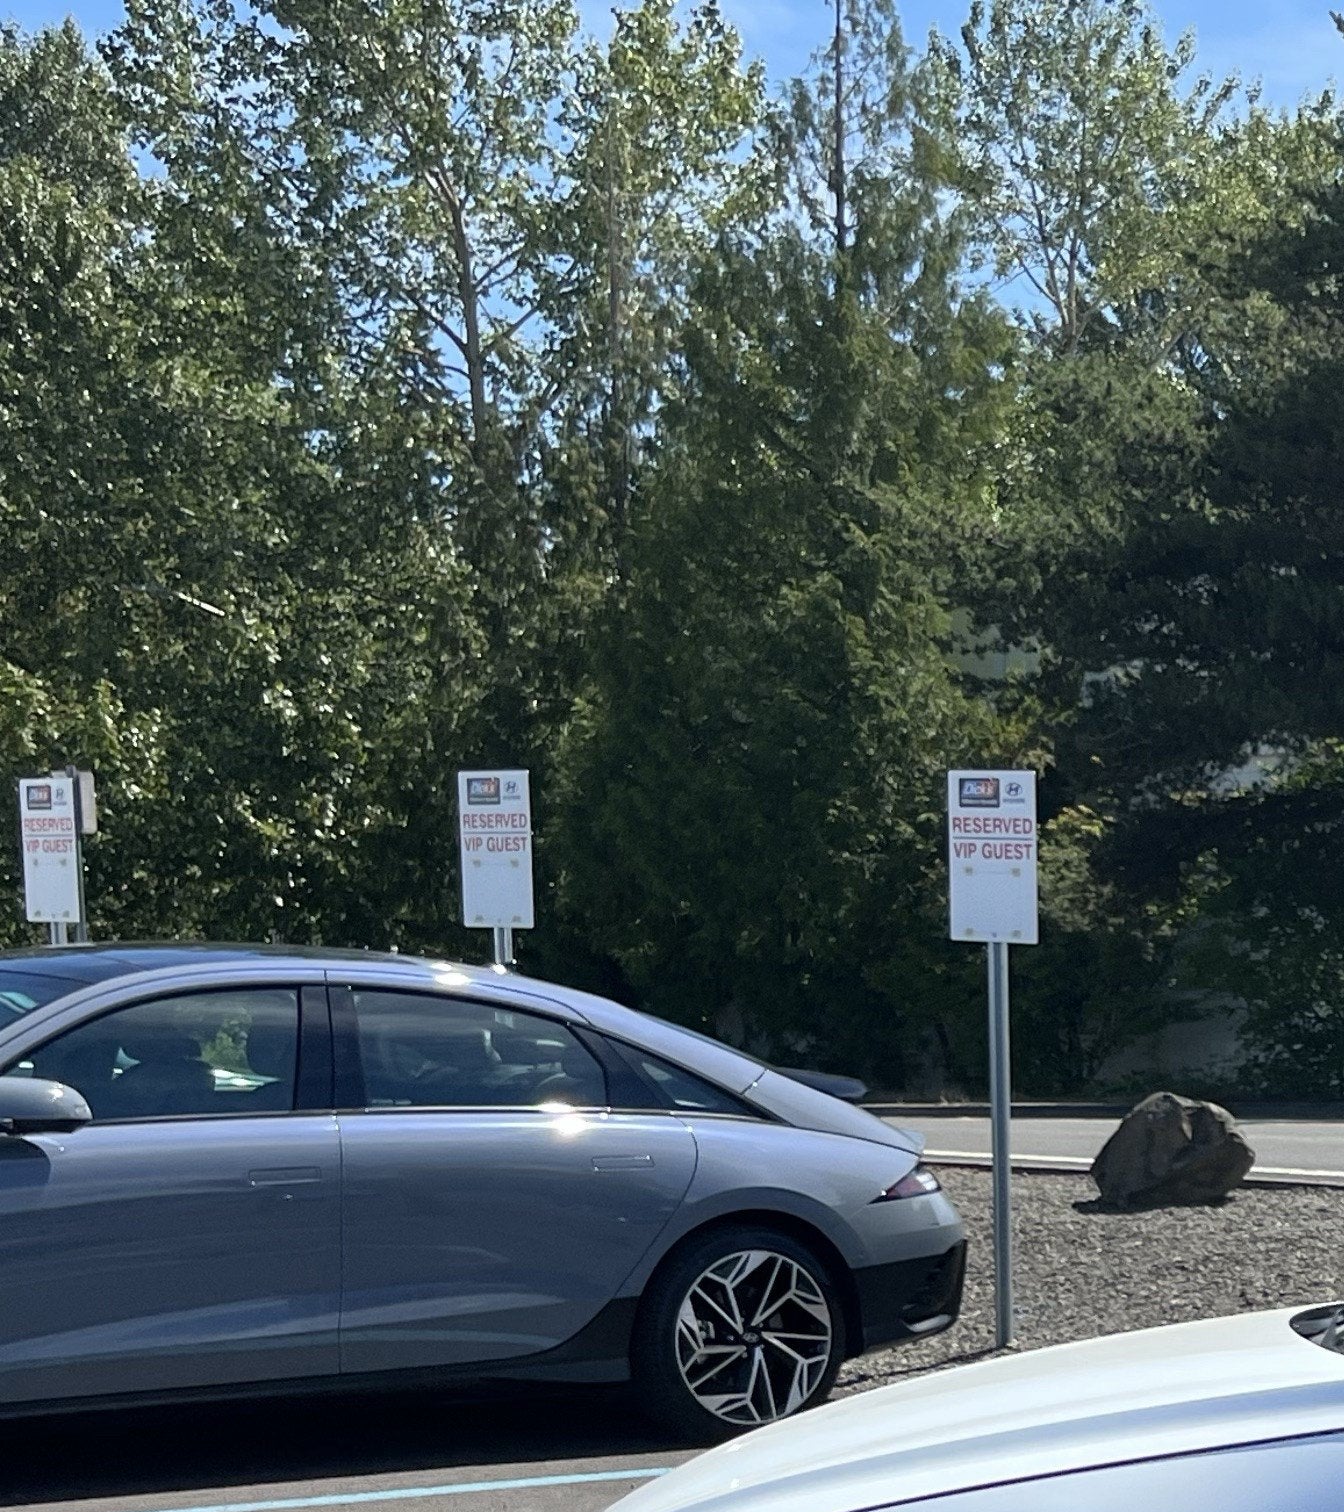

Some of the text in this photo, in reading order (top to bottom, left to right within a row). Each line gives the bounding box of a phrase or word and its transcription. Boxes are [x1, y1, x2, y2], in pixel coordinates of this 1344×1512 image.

[24, 817, 73, 832] RESERVED
[463, 813, 527, 828] RESERVED
[952, 817, 1033, 834] RESERVED
[26, 839, 73, 853] VIP GUEST
[464, 836, 527, 852] VIP GUEST
[953, 842, 1032, 860] VIP GUEST
